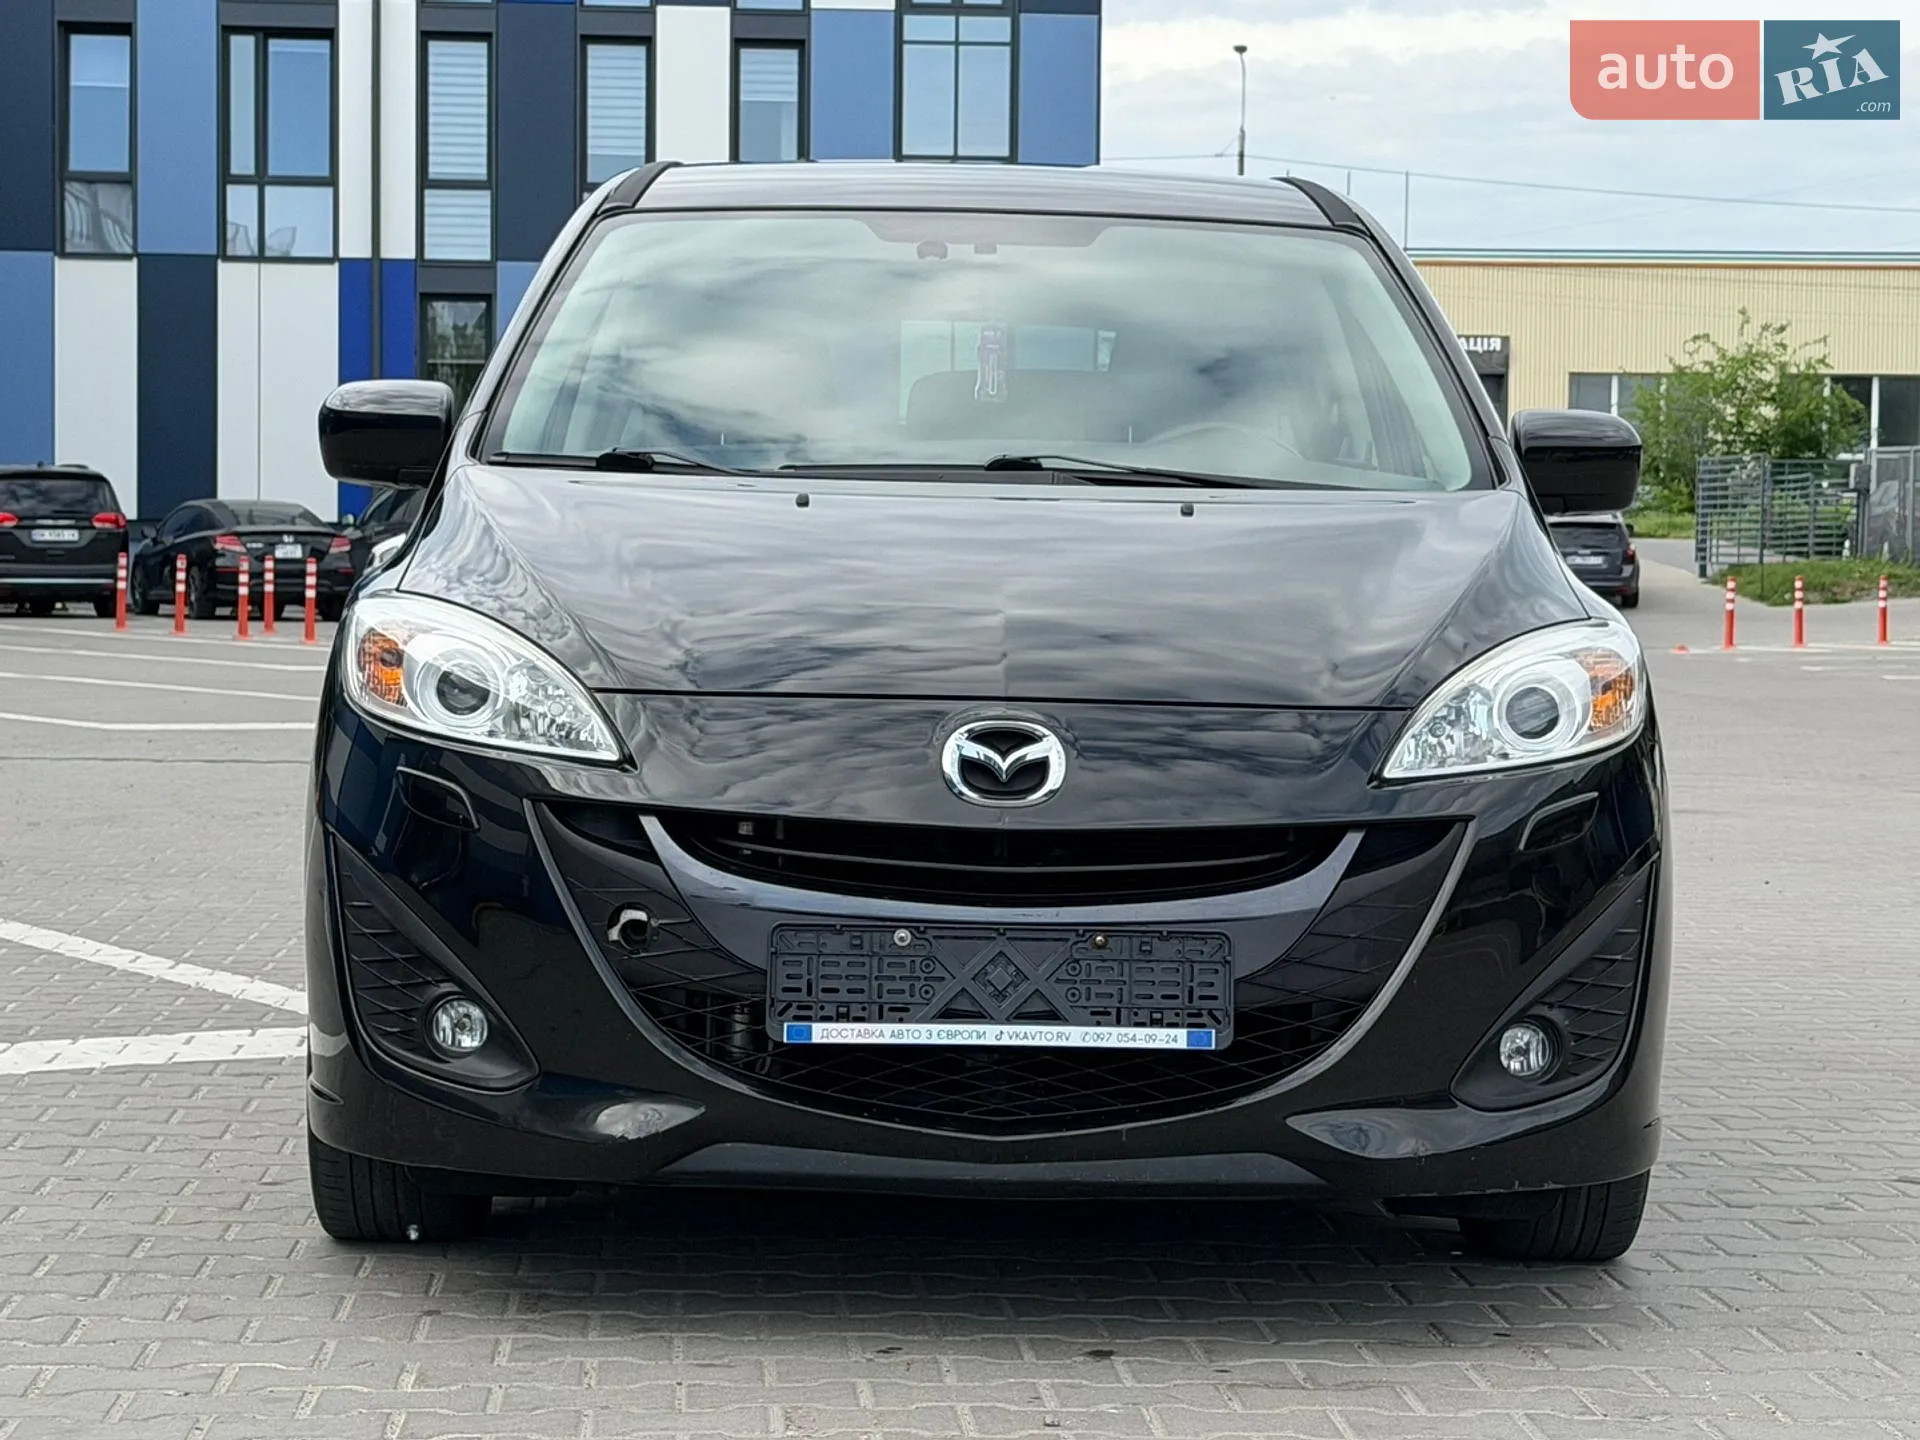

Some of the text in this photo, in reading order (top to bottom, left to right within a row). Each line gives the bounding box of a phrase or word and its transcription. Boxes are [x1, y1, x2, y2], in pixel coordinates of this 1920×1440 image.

[820, 1027, 885, 1040] ДОСТАВКА
[889, 1029, 921, 1040] АВТО
[937, 1029, 987, 1041] ЄВРОПИ
[1092, 1032, 1179, 1044] 097 054-09-24
